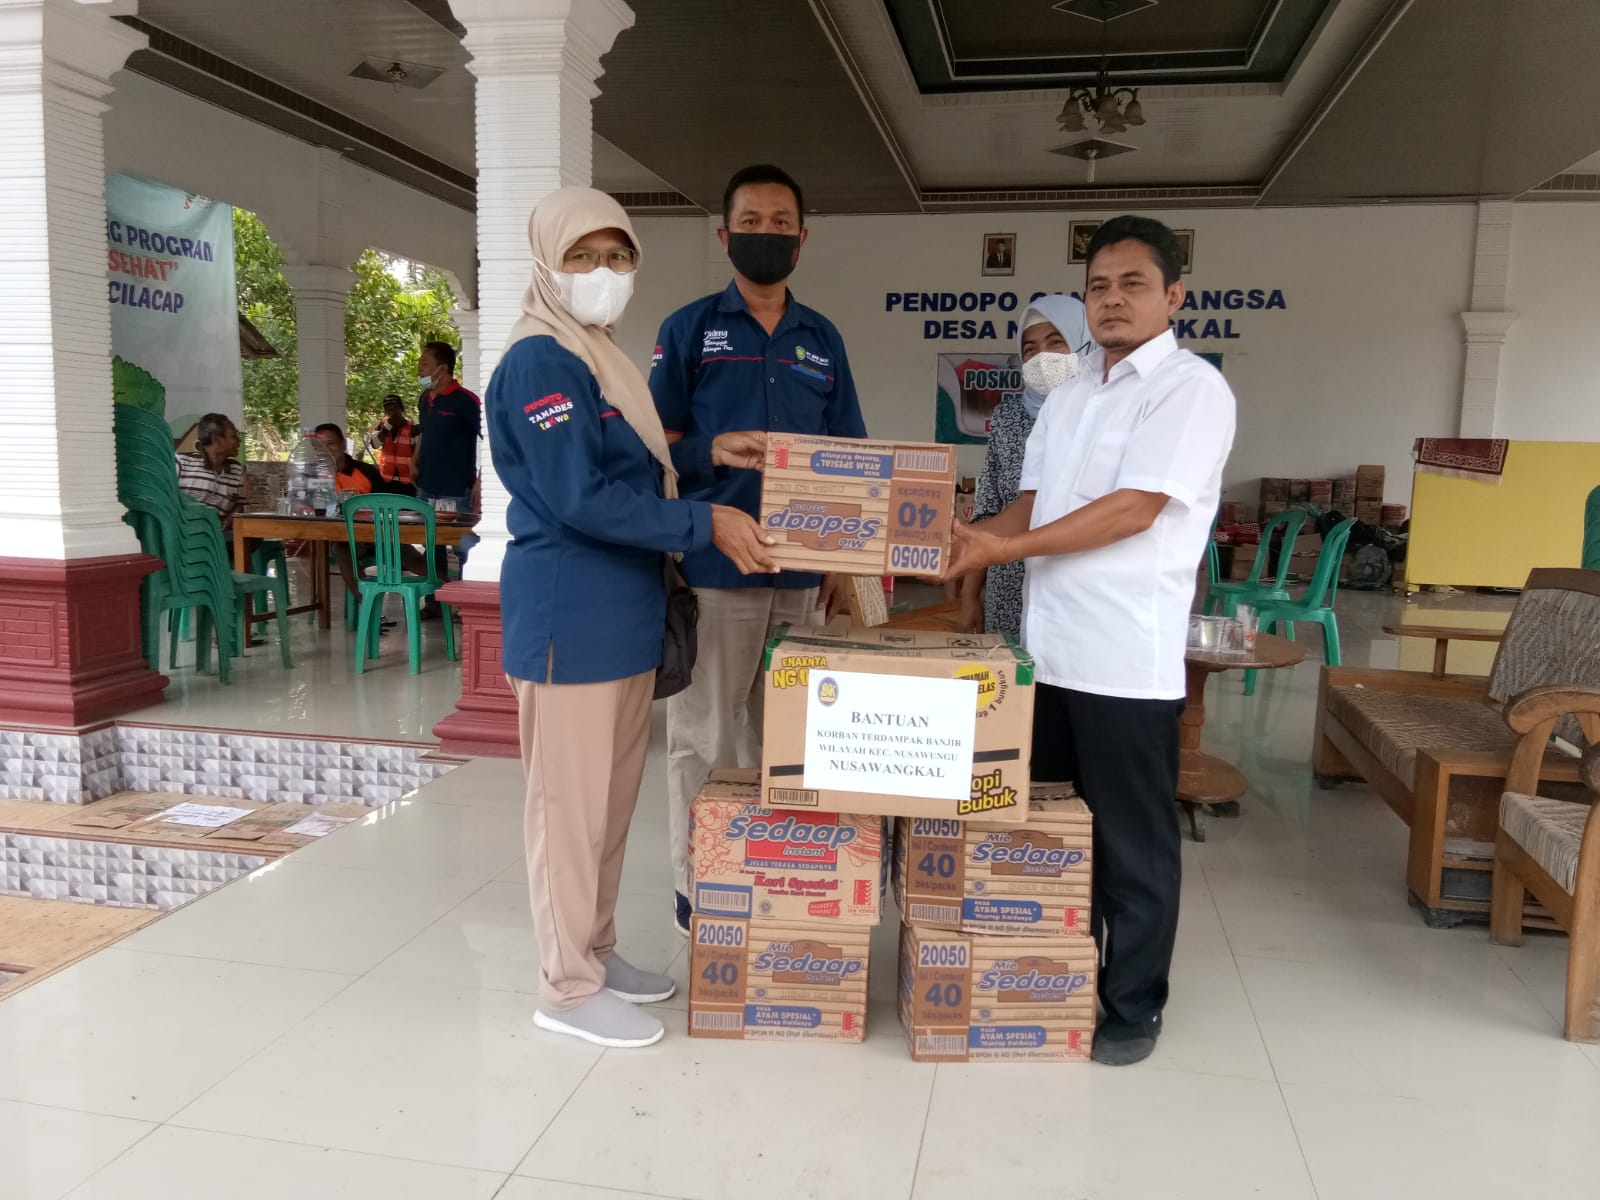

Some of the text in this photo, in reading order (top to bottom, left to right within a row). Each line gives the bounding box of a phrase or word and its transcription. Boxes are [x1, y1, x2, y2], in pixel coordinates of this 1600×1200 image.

[108, 281, 185, 313] CILACAP
[886, 292, 1018, 312] PENDOPO
[1179, 289, 1287, 310] ANGSA
[924, 320, 997, 339] DESA
[965, 369, 1022, 390] POSKO
[528, 401, 574, 424] TAMADES
[820, 459, 881, 470] AYAM SPESIAL
[766, 508, 881, 539] Sedaap
[898, 502, 937, 528] 40
[839, 537, 865, 549] Mie
[891, 546, 940, 569] 20050
[782, 656, 828, 668] ENAKNYA
[977, 682, 996, 694] ELAS
[851, 711, 930, 727] BANTUAN
[817, 729, 962, 747] KORBAN TERDAMPAK BANJIR
[819, 743, 866, 755] WILAYAH
[894, 749, 958, 761] NUSAWUNGU
[829, 760, 945, 778] NUSAWANGKAL
[971, 769, 1002, 792] opi
[742, 804, 773, 816] Mie
[957, 786, 1017, 815] Bubuk
[724, 815, 857, 850] Sedaap
[913, 817, 960, 837] 20050
[985, 832, 1013, 844] Mie
[918, 853, 956, 878] 40
[971, 842, 1085, 870] Sedaap
[974, 905, 1032, 915] AYAM SPESIAL
[698, 923, 743, 946] 20050
[767, 942, 793, 953] Mie
[920, 945, 966, 966] 20050
[702, 961, 738, 986] 40
[753, 953, 863, 978] Sedaap
[992, 960, 1019, 971] Mie
[978, 970, 1088, 994] Sedaap
[924, 983, 962, 1008] 40
[755, 1011, 812, 1021] AYAM SPESIAL
[980, 1032, 1037, 1041] AYAM SPESIAL
